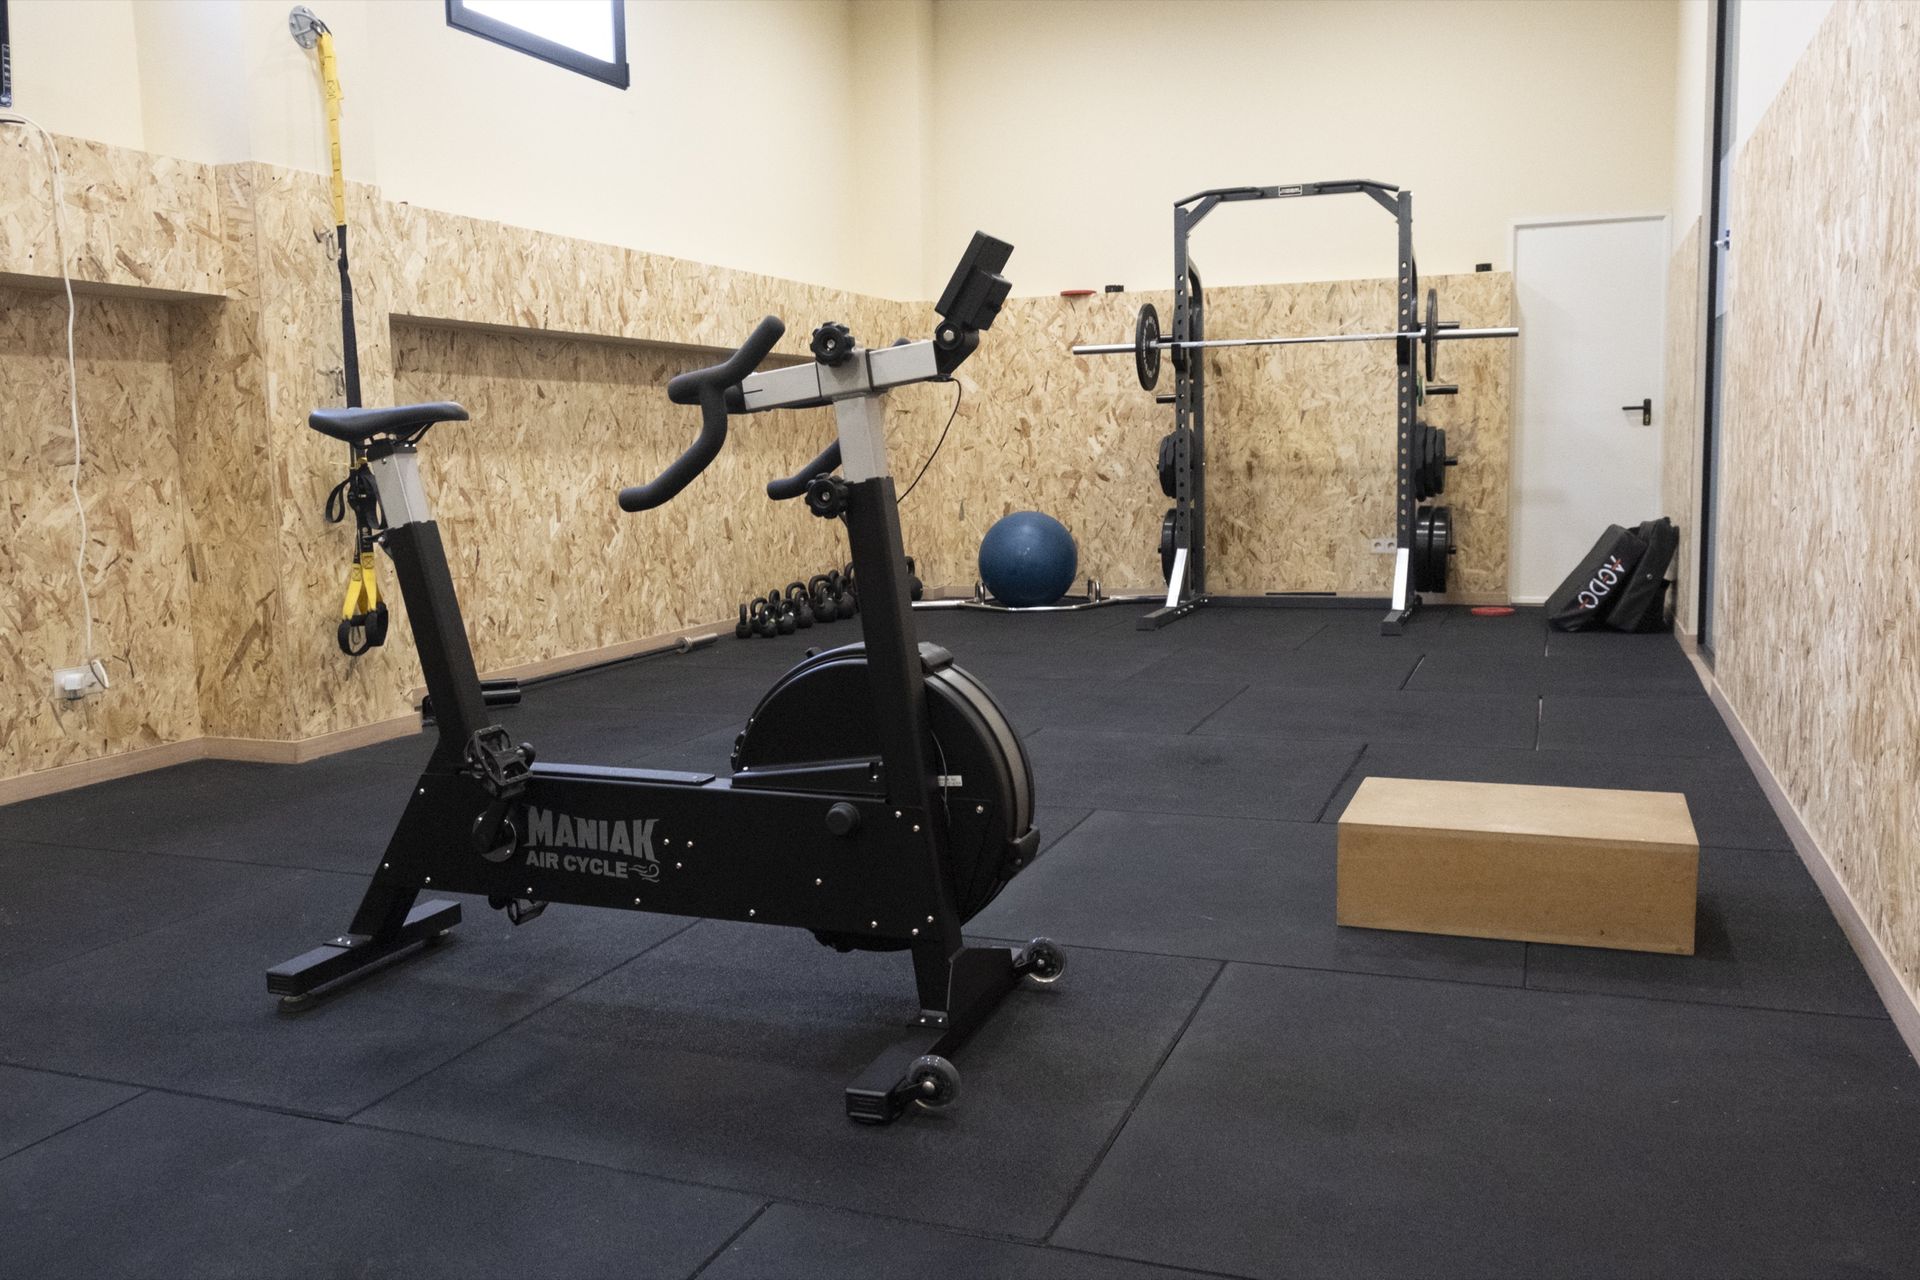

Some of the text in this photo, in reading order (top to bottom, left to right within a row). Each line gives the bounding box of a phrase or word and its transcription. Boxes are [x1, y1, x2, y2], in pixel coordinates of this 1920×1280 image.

[523, 804, 660, 863] MANIAK
[525, 850, 629, 879] AIR CYCLE
